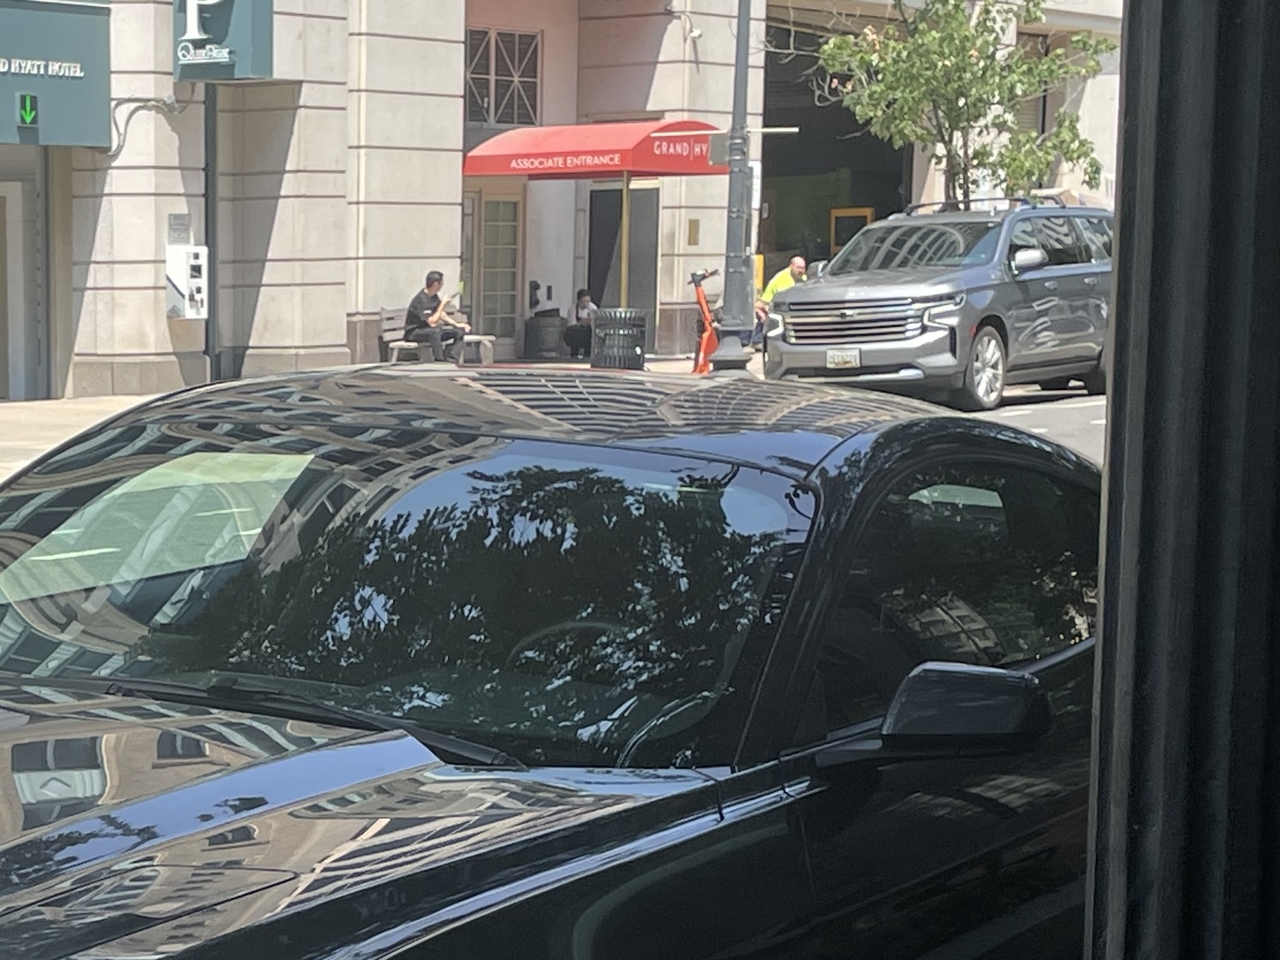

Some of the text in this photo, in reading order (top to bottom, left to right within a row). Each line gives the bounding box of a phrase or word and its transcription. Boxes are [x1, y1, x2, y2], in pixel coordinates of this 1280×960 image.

[11, 59, 47, 75] HYATT
[48, 61, 85, 77] HOTEL
[653, 141, 690, 157] GRAND
[510, 153, 621, 169] ASSOCIATE ENTRANCE
